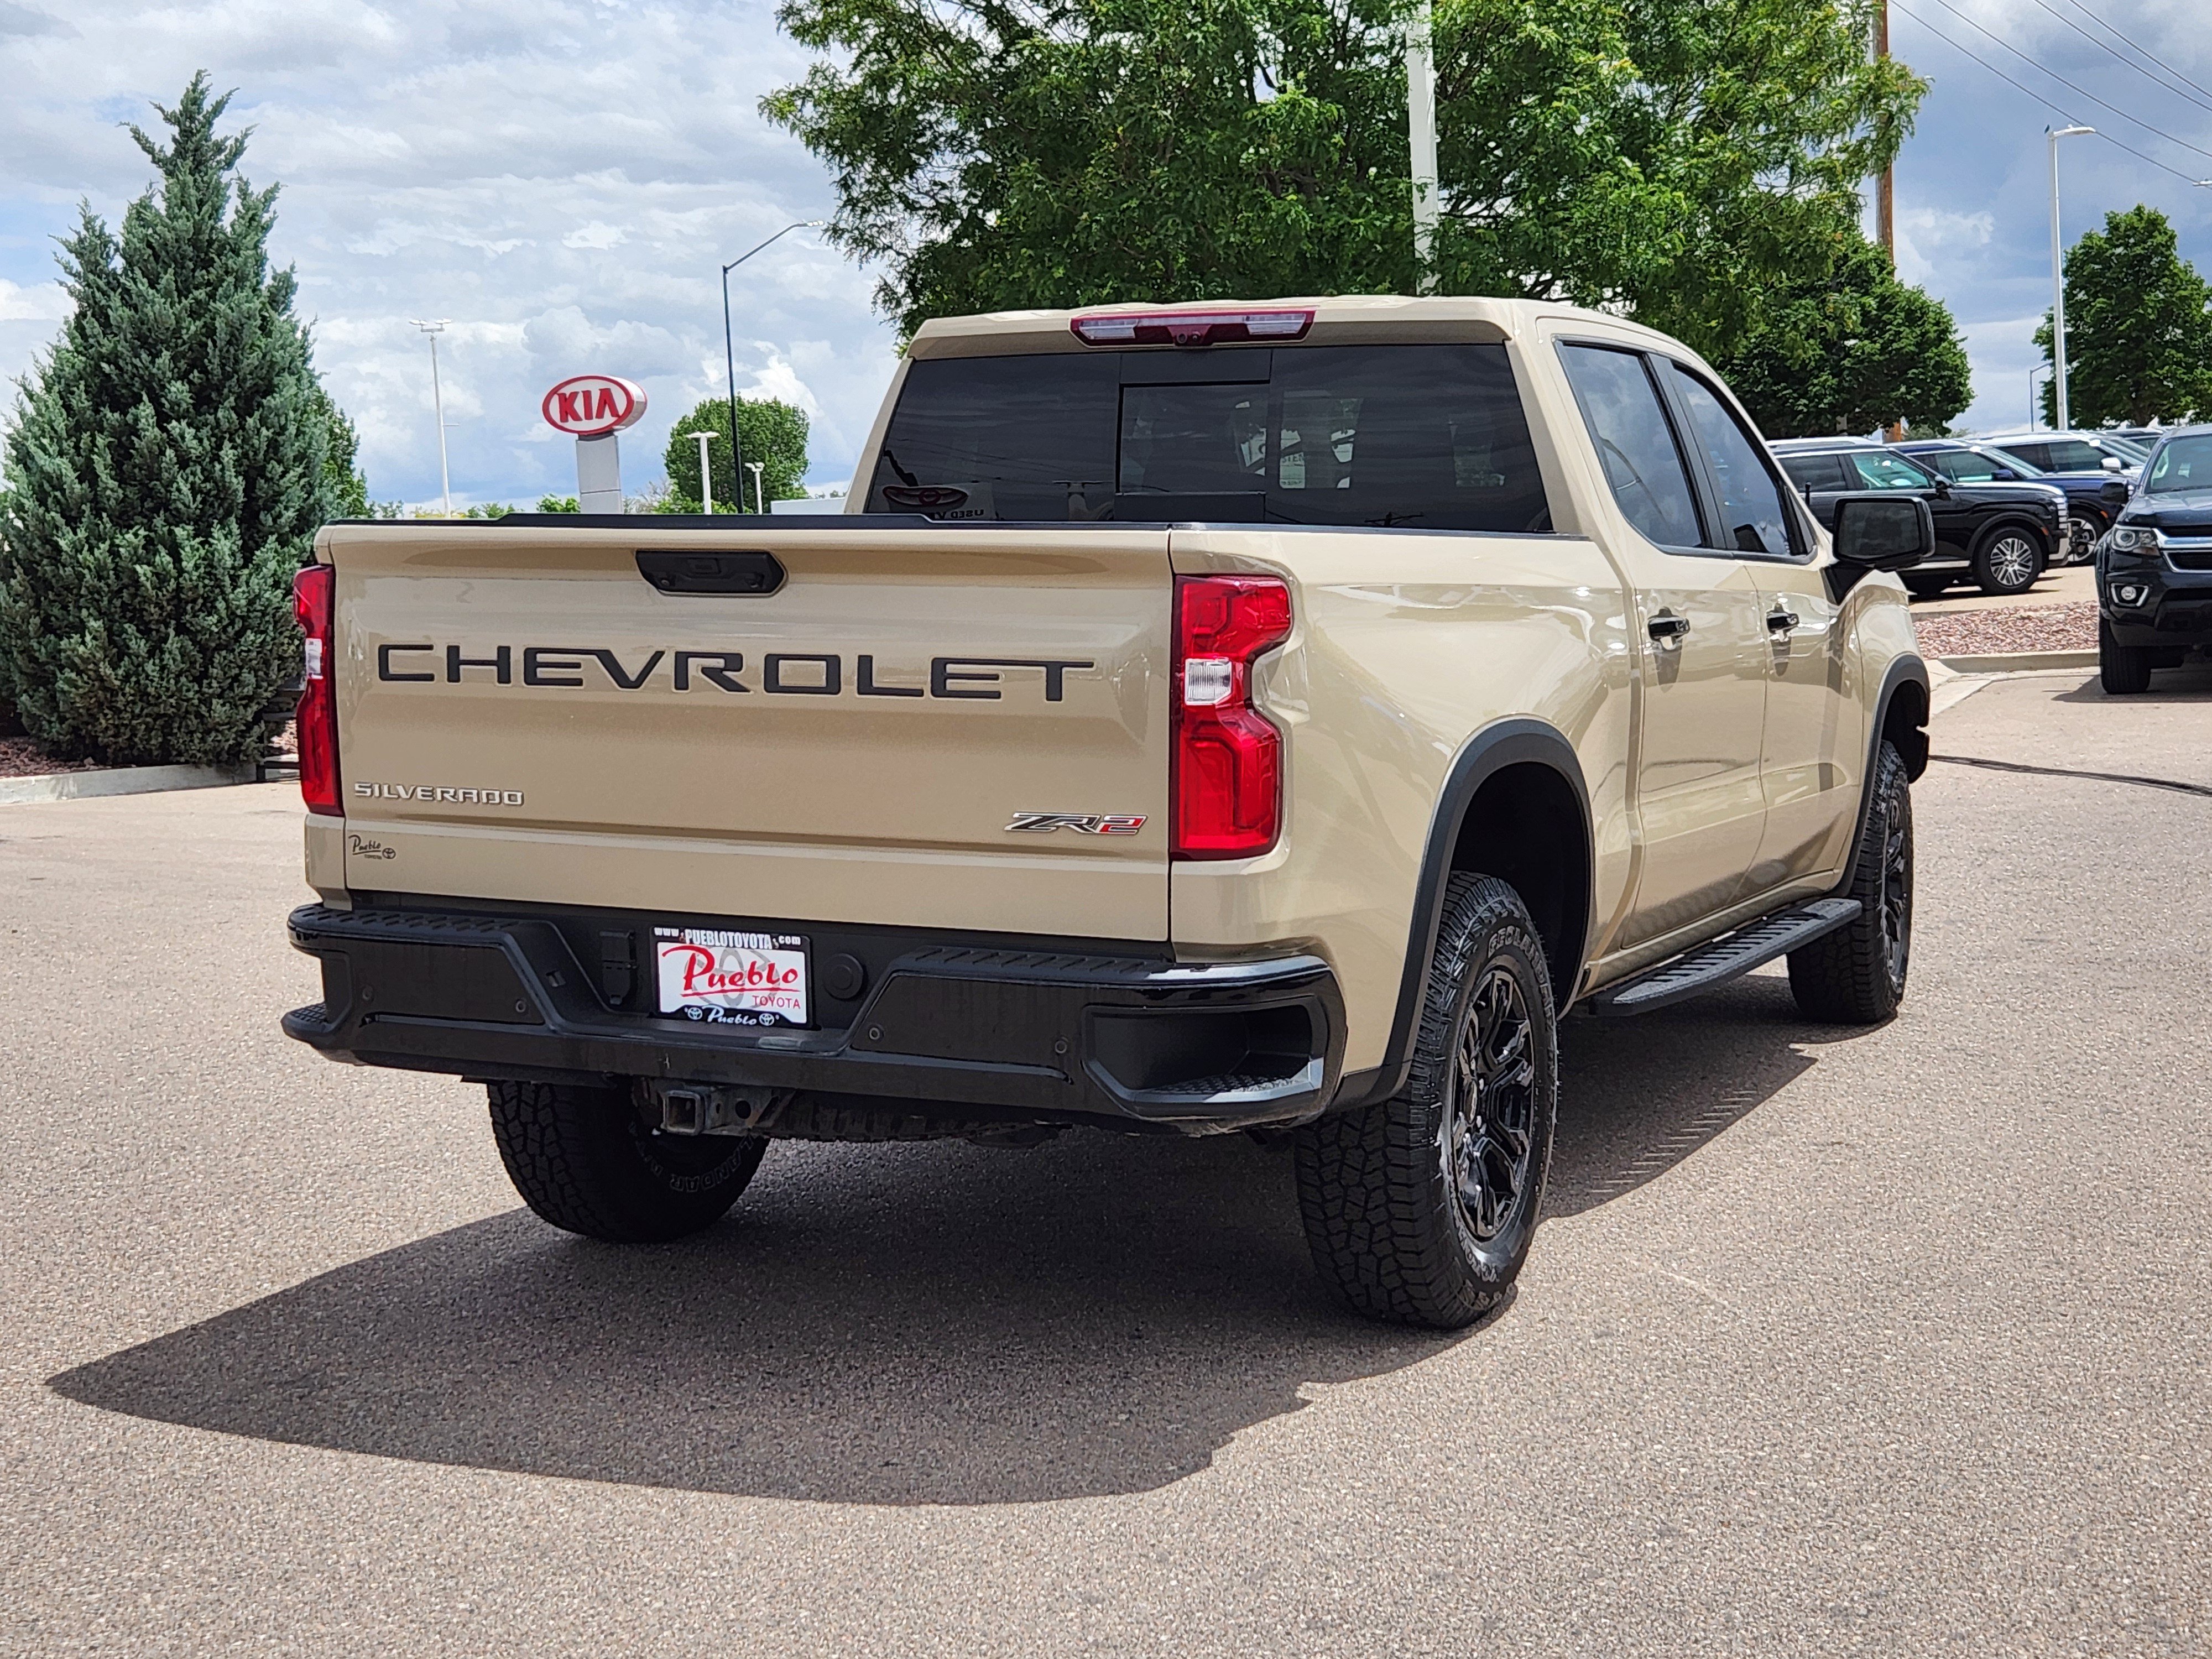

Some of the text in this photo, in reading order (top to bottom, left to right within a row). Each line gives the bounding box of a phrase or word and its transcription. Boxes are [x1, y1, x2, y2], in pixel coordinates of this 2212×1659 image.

[556, 388, 620, 422] KIA
[378, 644, 1095, 702] CHEVROLET
[354, 782, 524, 805] SILVERADO
[1004, 812, 1147, 834] ZR2
[662, 945, 798, 990] Pueblo
[752, 995, 800, 1009] TOYOTA
[702, 1005, 757, 1025] Pueblo
